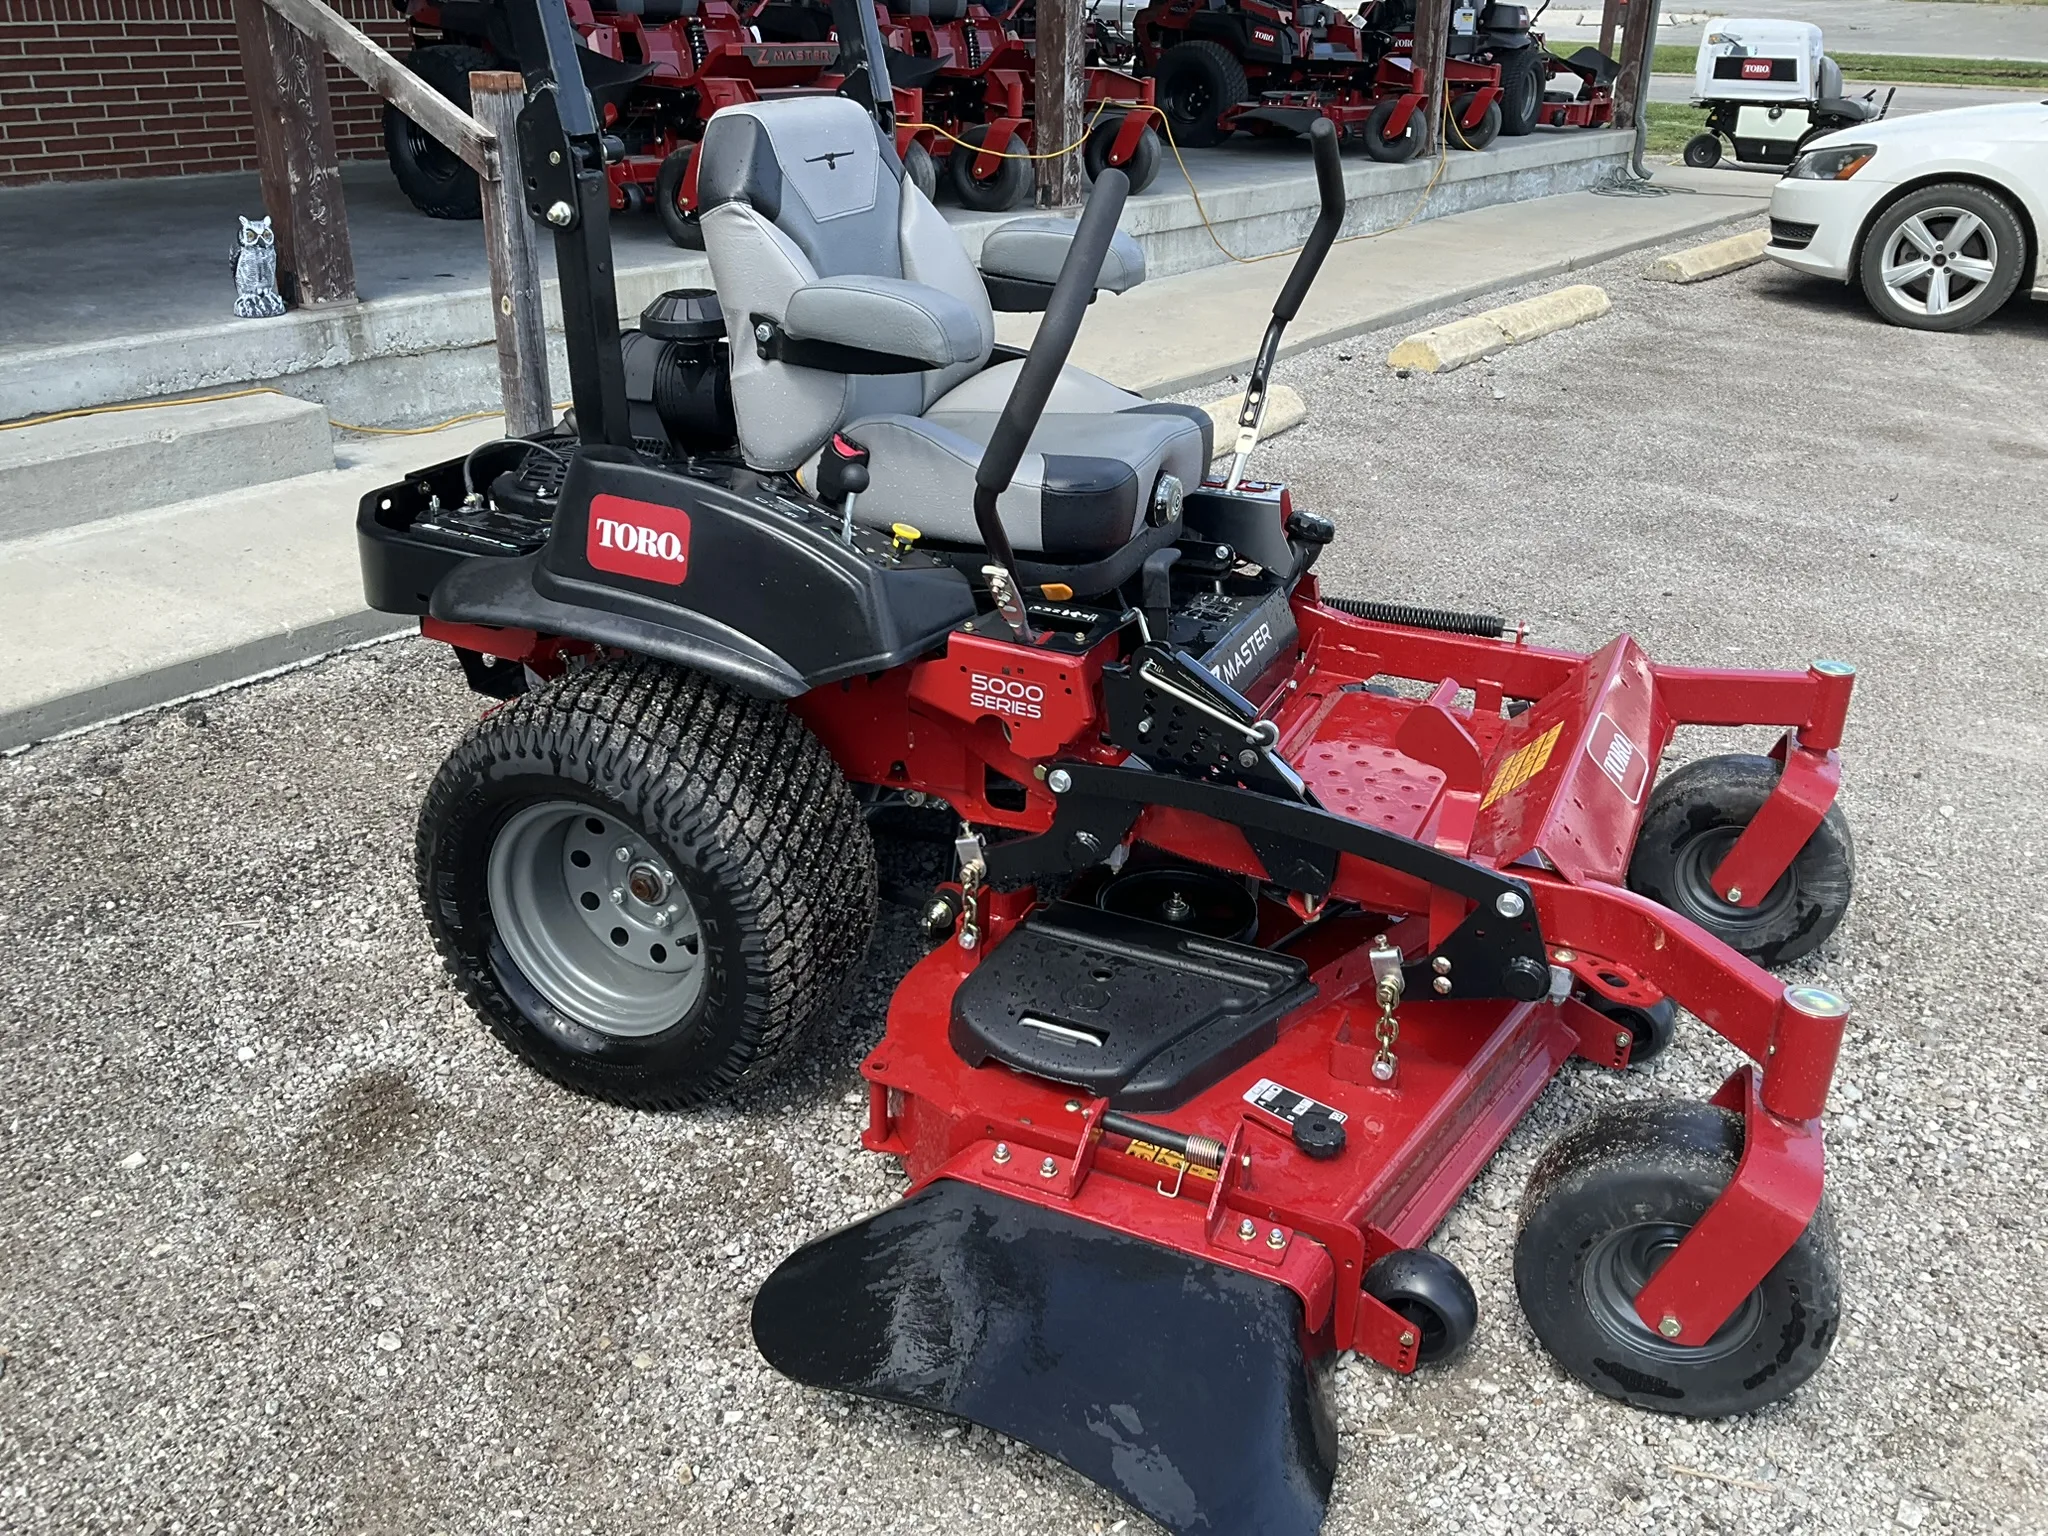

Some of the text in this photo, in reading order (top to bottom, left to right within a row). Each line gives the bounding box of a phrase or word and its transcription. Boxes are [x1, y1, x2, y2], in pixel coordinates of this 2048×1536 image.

[757, 48, 831, 65] Z MASTER
[1222, 621, 1273, 685] MASTER
[971, 673, 1044, 702] 5000
[970, 692, 1042, 719] SERIES
